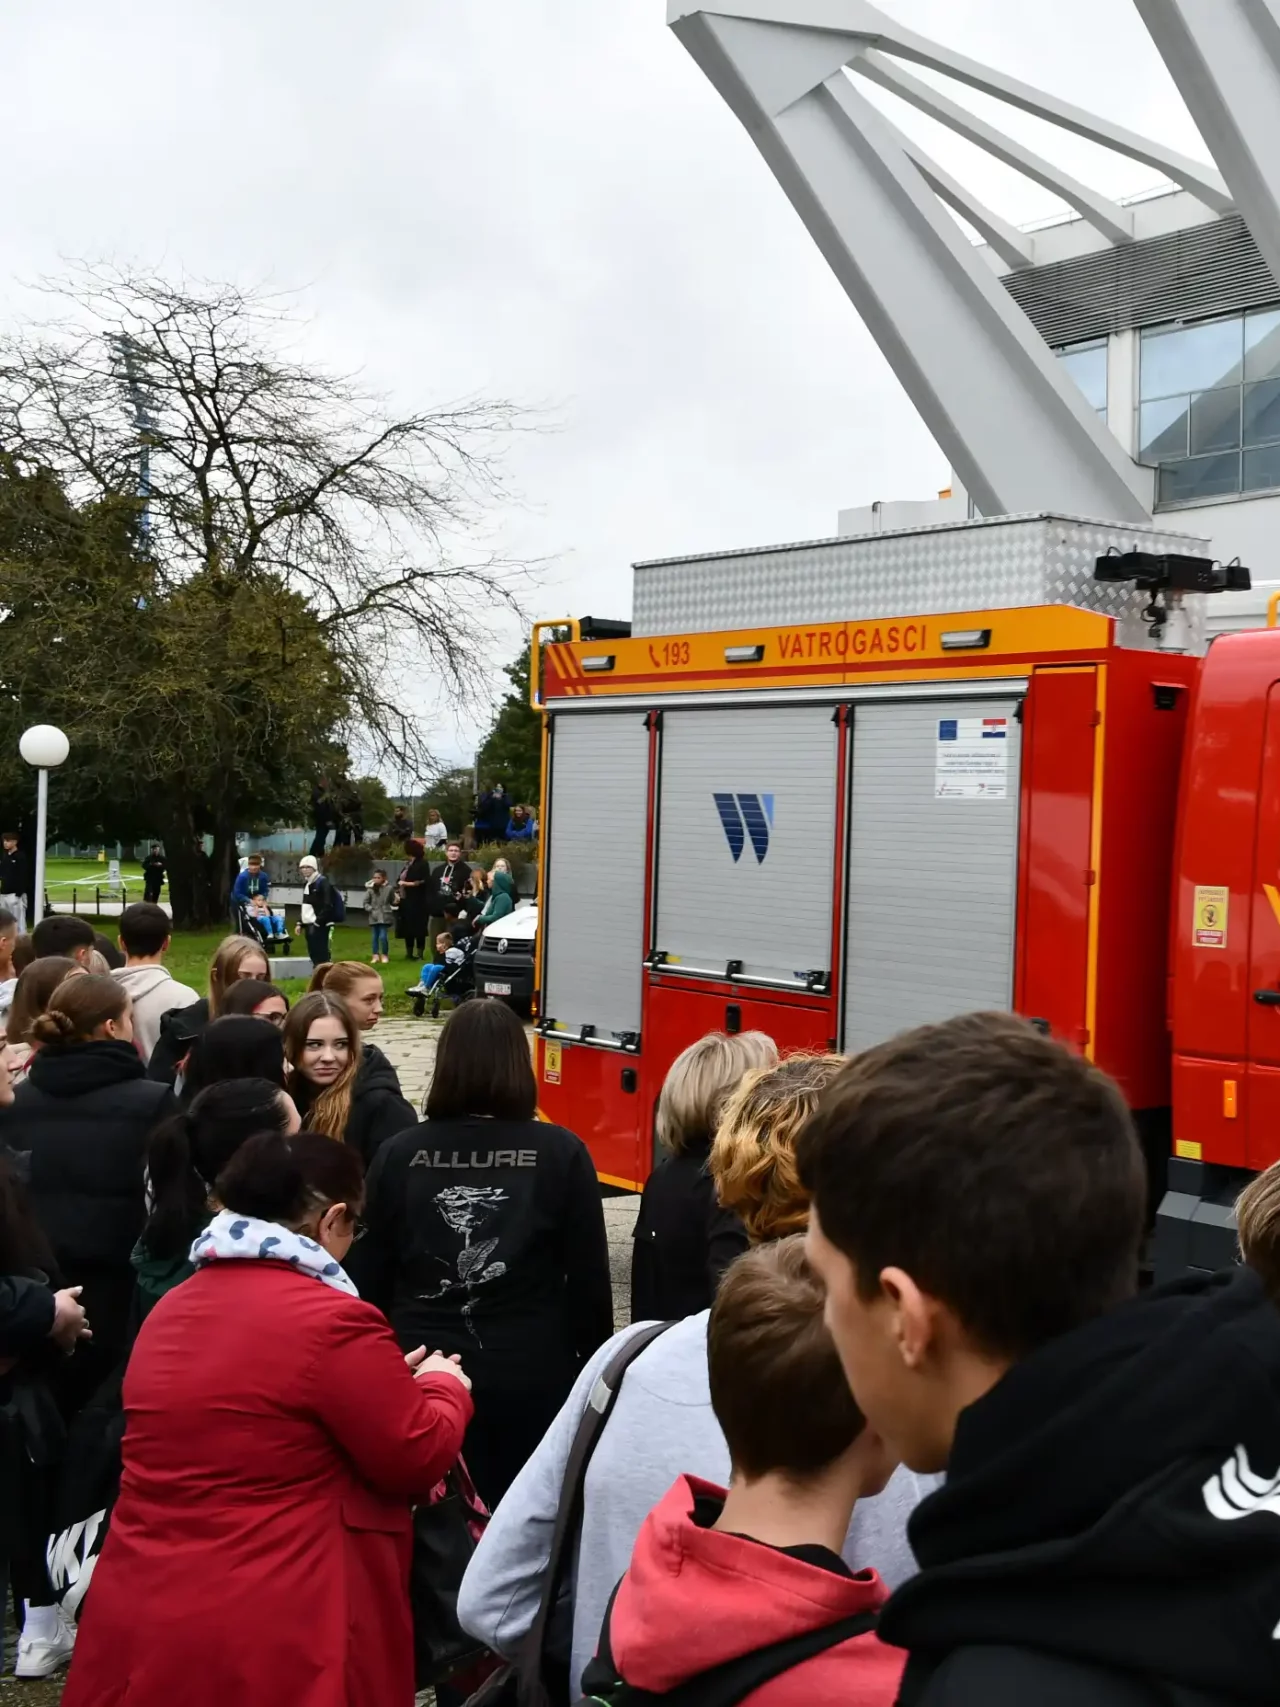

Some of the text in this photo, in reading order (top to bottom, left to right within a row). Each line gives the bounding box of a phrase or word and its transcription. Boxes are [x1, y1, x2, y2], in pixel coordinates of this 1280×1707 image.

[662, 641, 691, 666] 193
[777, 624, 927, 659] VATROGASCI
[409, 1149, 538, 1169] ALLURE
